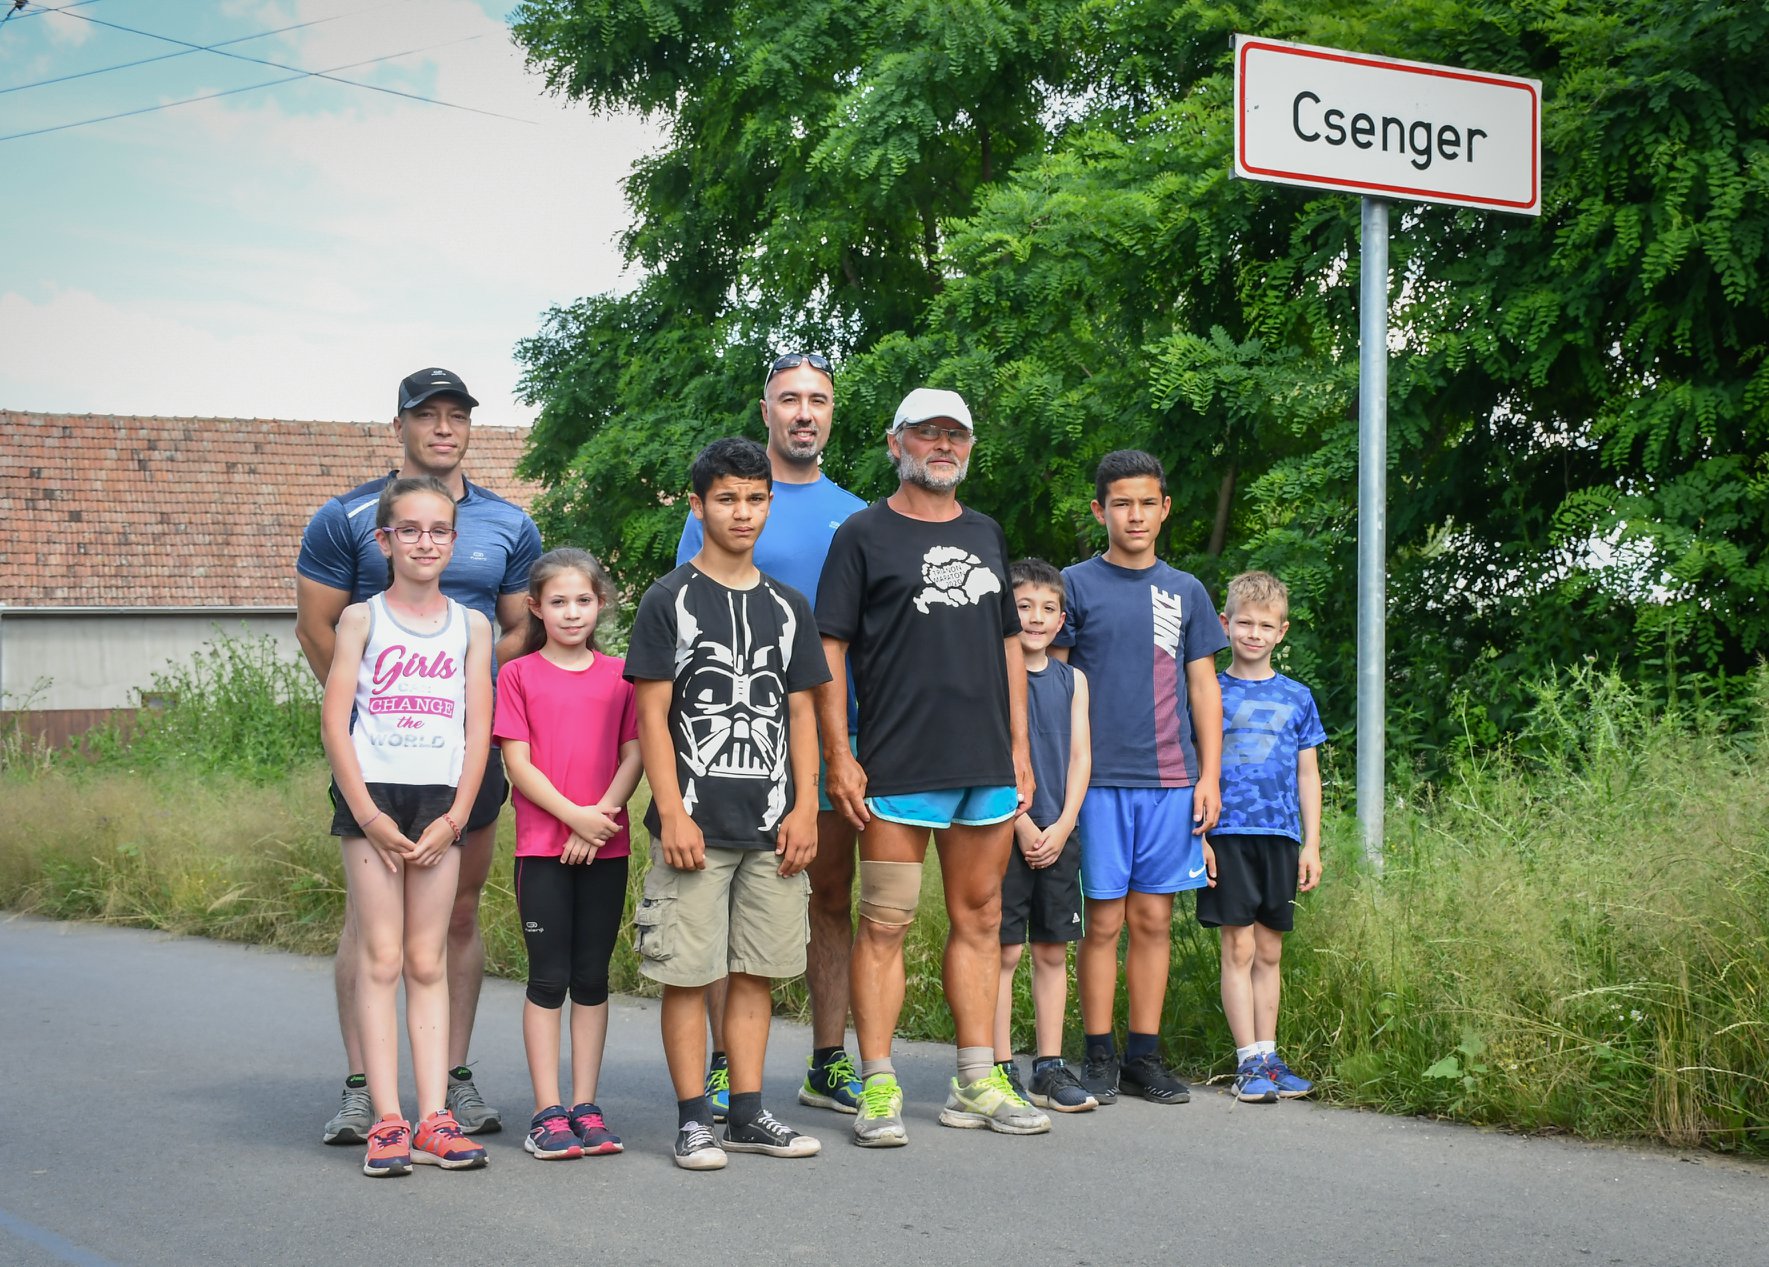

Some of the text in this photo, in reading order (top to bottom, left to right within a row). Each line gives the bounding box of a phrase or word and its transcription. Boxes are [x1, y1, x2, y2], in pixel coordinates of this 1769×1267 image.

[1293, 91, 1488, 171] Csenger
[1150, 584, 1182, 659] NIKE
[372, 645, 457, 695] Girls
[369, 698, 454, 716] CHANGE
[396, 716, 425, 729] the
[369, 733, 445, 748] WORLD
